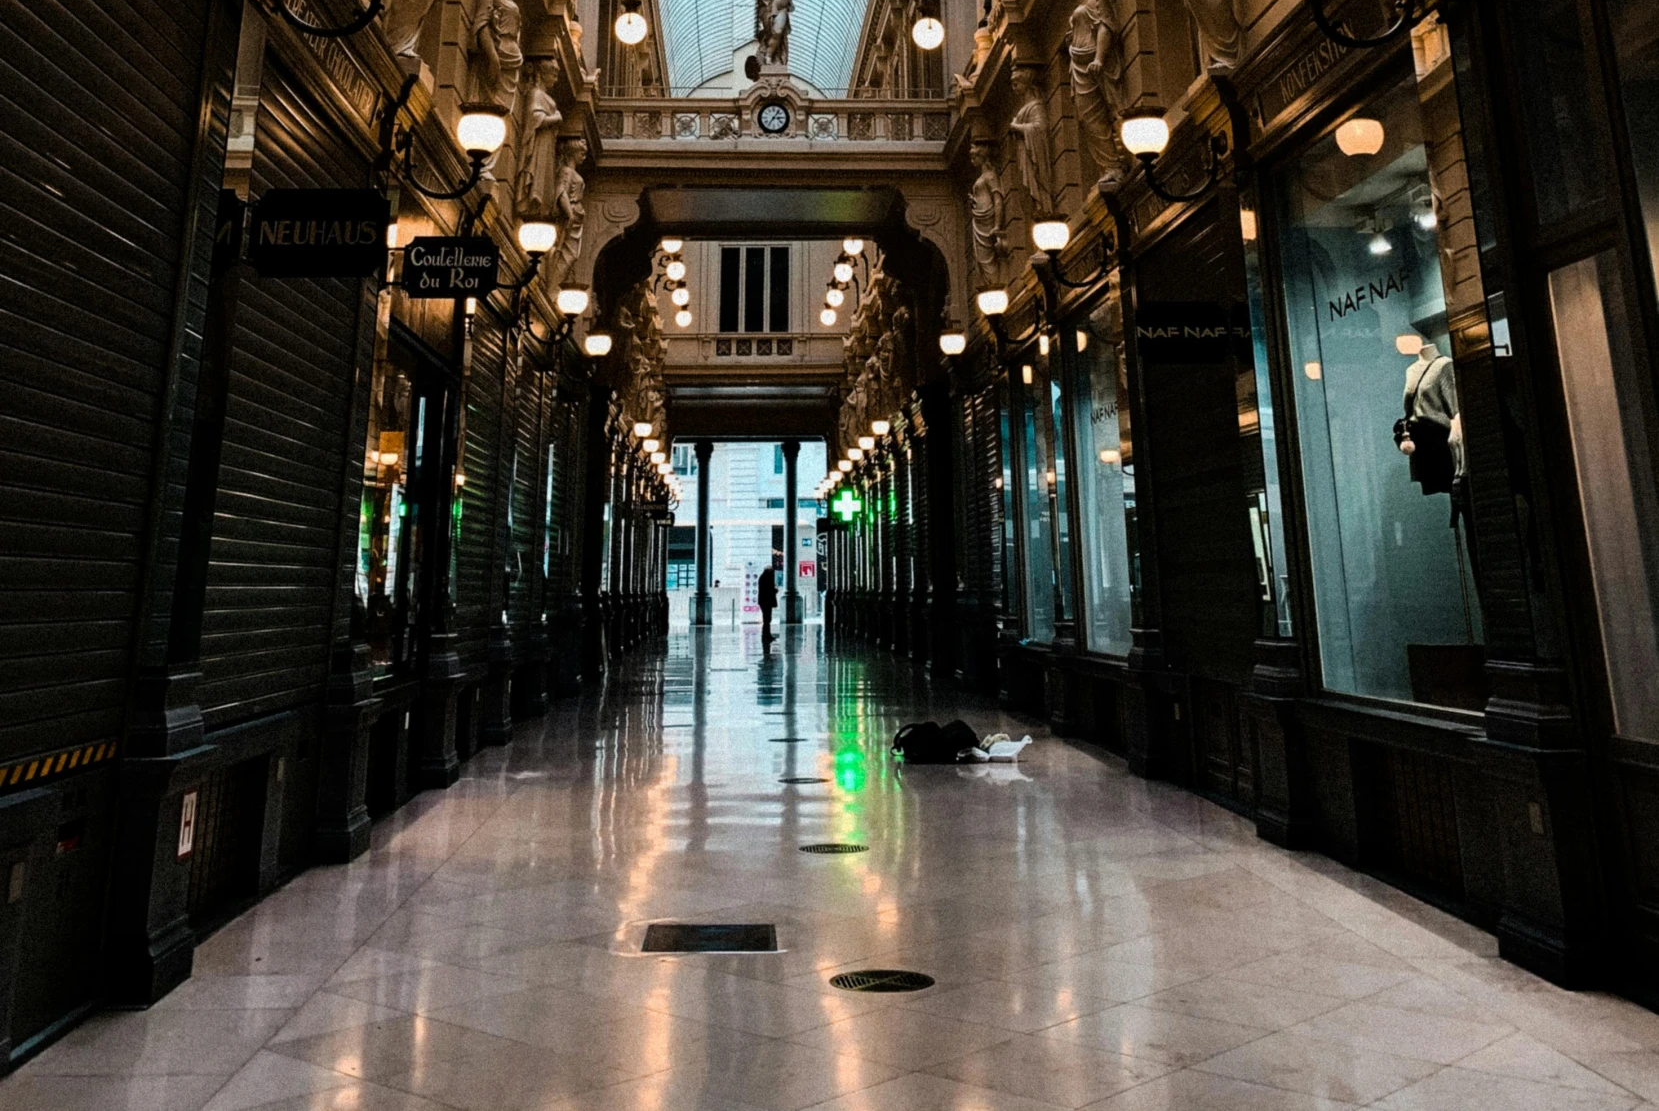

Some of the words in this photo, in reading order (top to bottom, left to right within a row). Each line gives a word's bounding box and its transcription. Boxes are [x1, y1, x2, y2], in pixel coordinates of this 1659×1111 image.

[258, 219, 378, 246] NEUHAUS
[410, 246, 492, 268] Coutellerie
[418, 270, 440, 289] du
[449, 267, 480, 290] Roi
[1328, 285, 1366, 322] NAF
[1136, 325, 1180, 339] NAF
[1183, 325, 1227, 339] NAF
